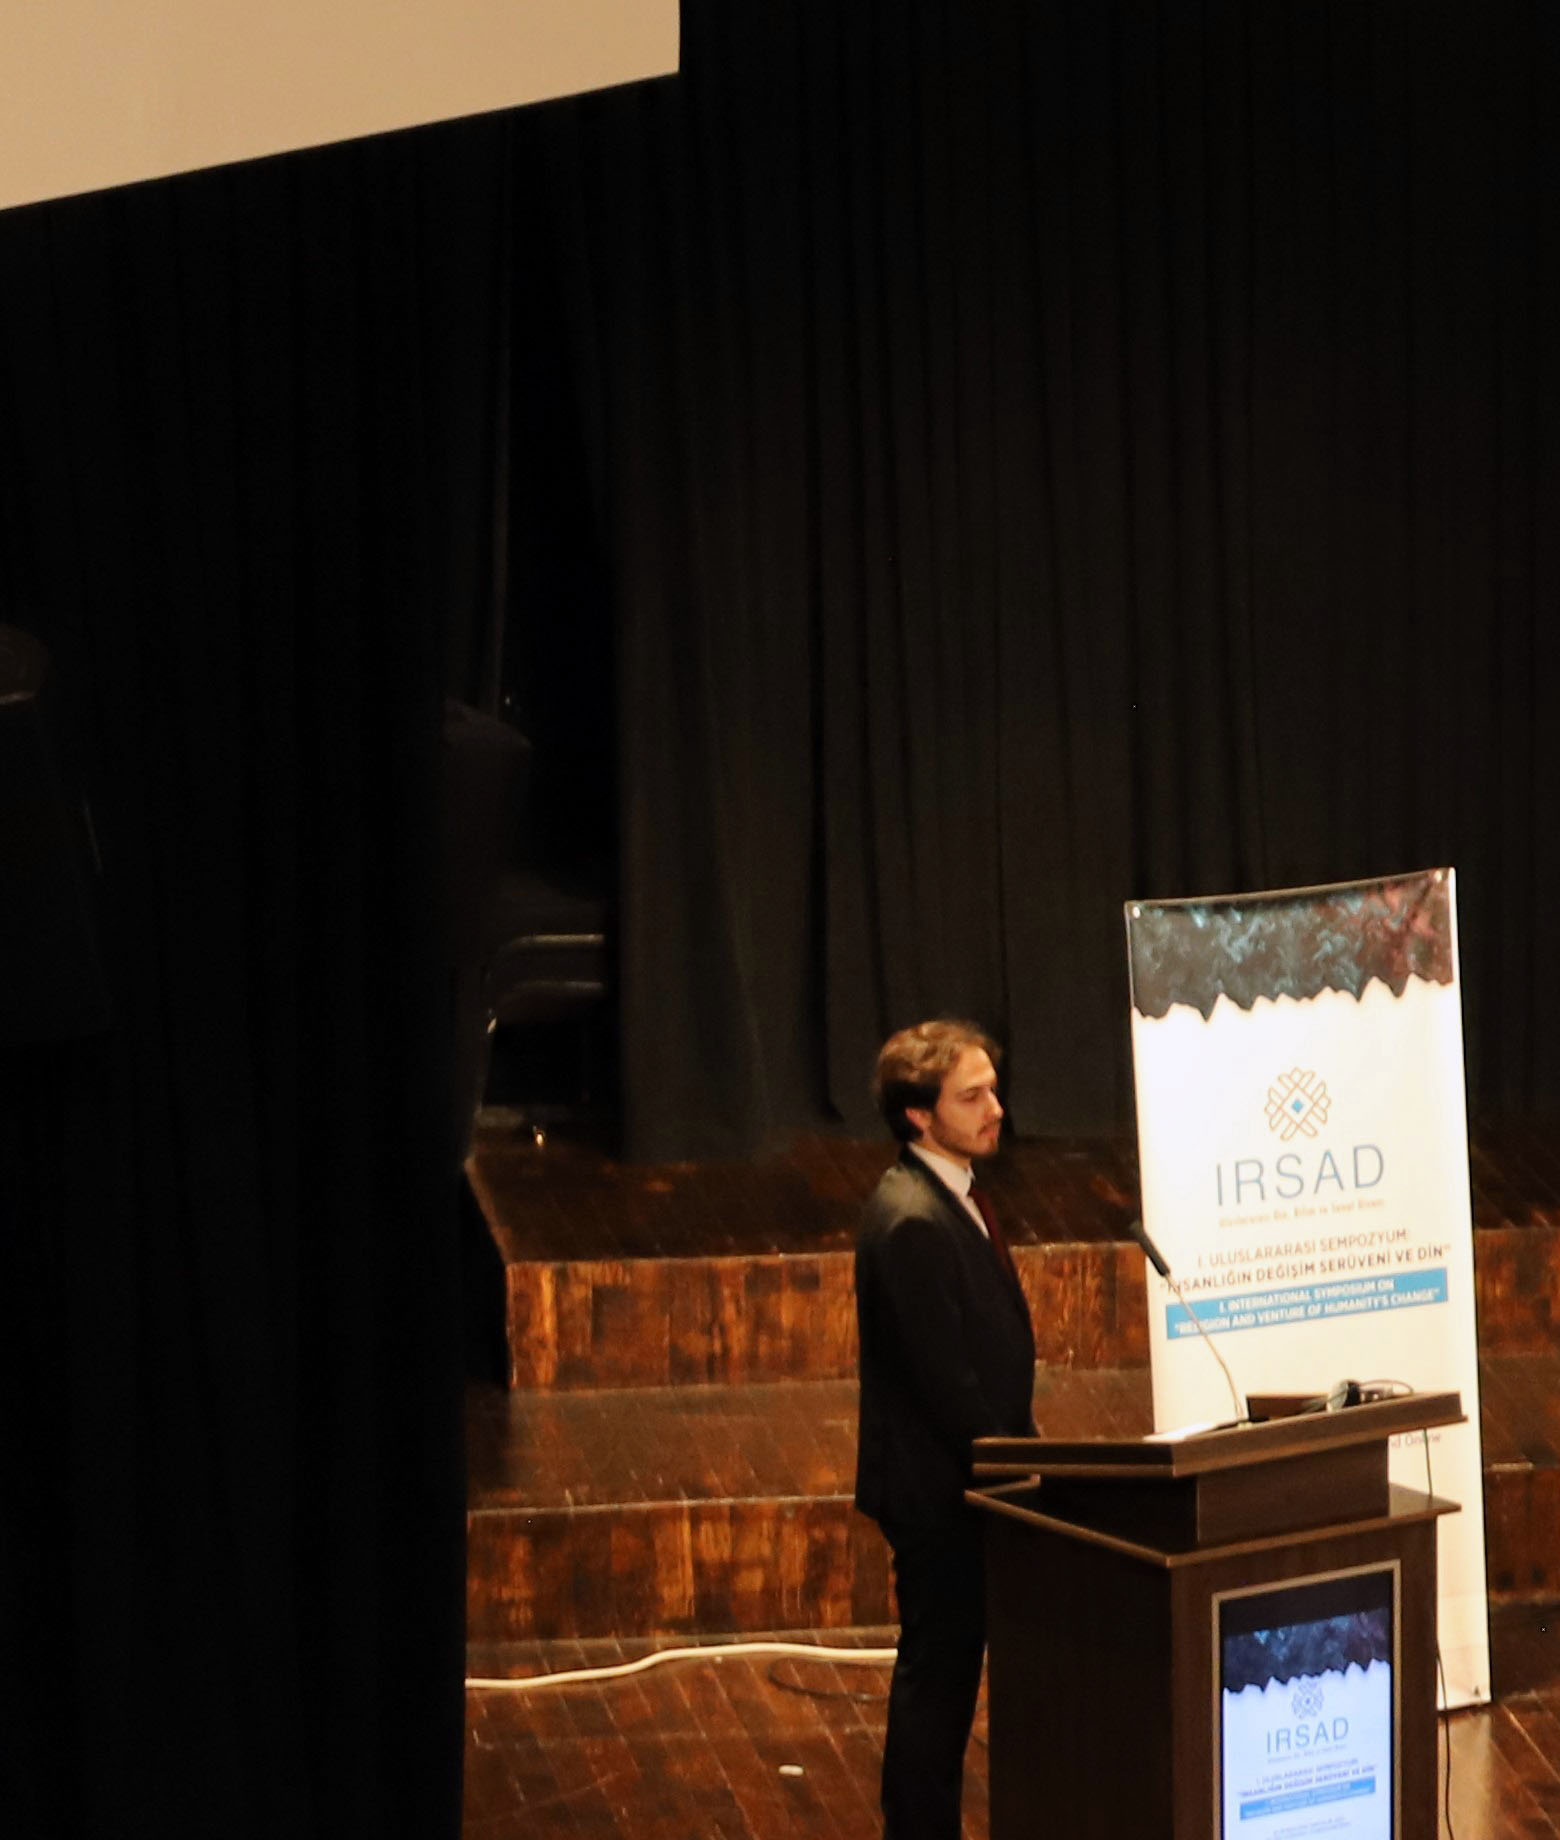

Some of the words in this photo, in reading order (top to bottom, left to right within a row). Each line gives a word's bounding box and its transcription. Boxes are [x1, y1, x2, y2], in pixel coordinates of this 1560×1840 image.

[1217, 1144, 1384, 1206] IRSAD
[1209, 1241, 1317, 1268] ULUSLARARASI
[1319, 1252, 1391, 1273] SERÜVENİ
[1394, 1249, 1413, 1263] VE
[1228, 1289, 1313, 1311] INTERNATIONAL
[1314, 1280, 1376, 1299] SYMPOSIUM
[1377, 1279, 1395, 1291] ON
[1232, 1312, 1256, 1328] AND
[1257, 1305, 1306, 1325] VENTURE
[1307, 1303, 1322, 1317] OF
[1266, 1717, 1349, 1754] IRSAD
